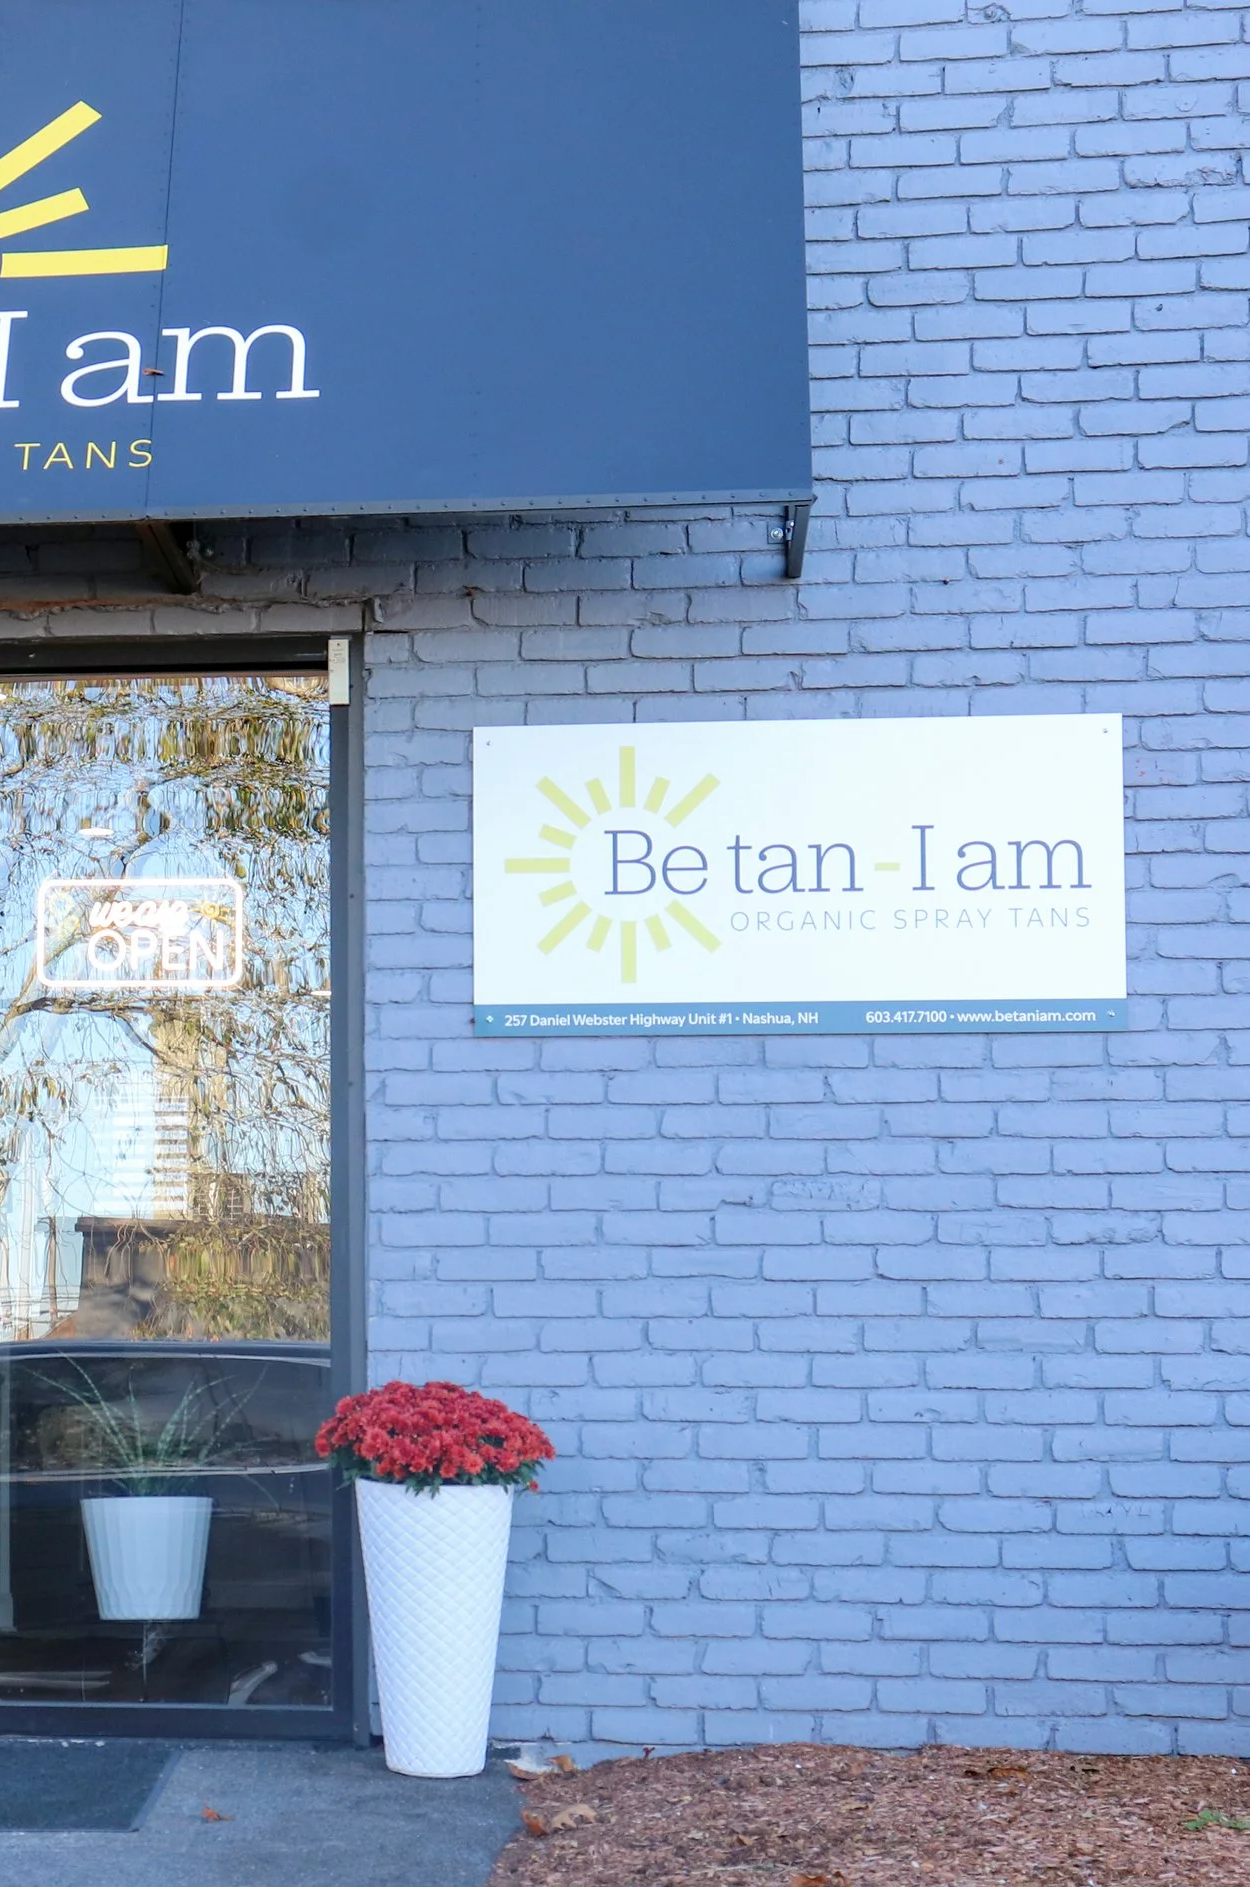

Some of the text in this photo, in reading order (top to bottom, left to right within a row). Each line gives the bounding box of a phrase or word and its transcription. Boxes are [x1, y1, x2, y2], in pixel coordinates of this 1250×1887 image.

[60, 324, 320, 408] am
[14, 439, 154, 470] TANS
[603, 829, 709, 896] Be
[956, 839, 1093, 892] am
[730, 906, 1090, 932] ORGANIC SPRAY TANS
[88, 929, 224, 971] OPEN
[504, 1011, 819, 1028] 257 Daniel Webster Highway Unit #1 Nashua, NH
[865, 1009, 1097, 1024] 603.417.7100 www.betaniam.com
